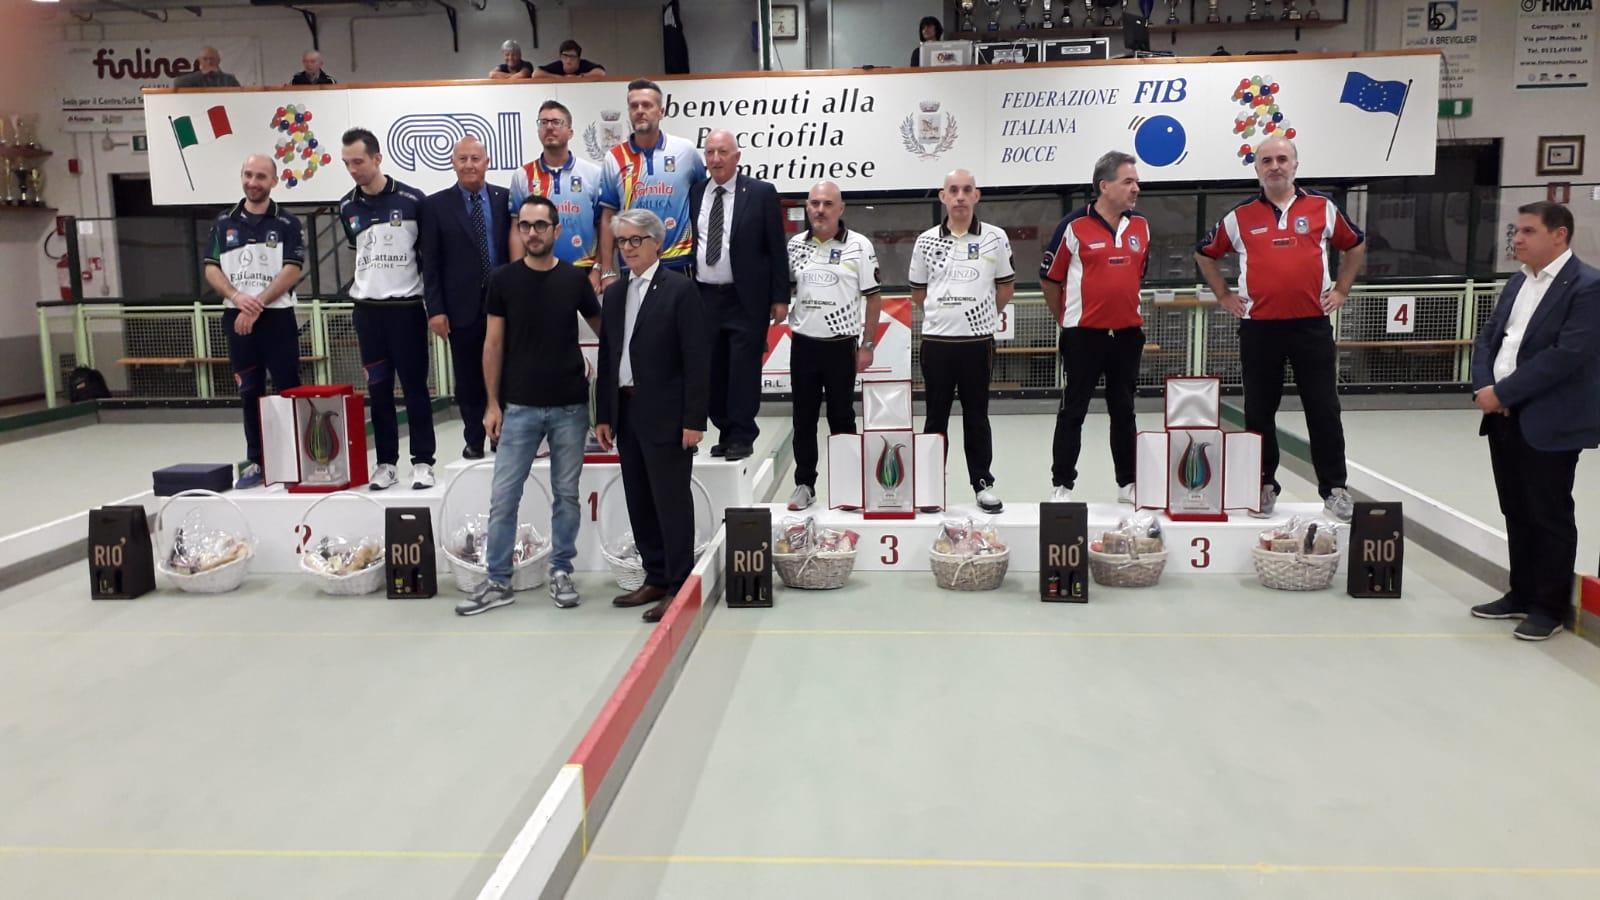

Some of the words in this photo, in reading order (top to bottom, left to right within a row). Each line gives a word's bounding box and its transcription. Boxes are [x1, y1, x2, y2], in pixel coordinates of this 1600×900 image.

[1540, 0, 1593, 12] FIRMA
[664, 90, 811, 119] benvenuti
[822, 87, 875, 114] alla
[1001, 88, 1120, 109] FEDERAZIONE
[1132, 77, 1187, 104] FIB
[696, 121, 844, 149] Bcciofila
[1001, 117, 1077, 137] ITALIANA
[1001, 145, 1058, 164] BOCCE
[736, 155, 876, 181] martinese
[372, 253, 408, 262] attanzi
[997, 311, 1008, 332] 3
[1393, 303, 1409, 326] 4
[587, 491, 598, 522] 1
[880, 534, 899, 565] 3
[1190, 537, 1210, 568] 3
